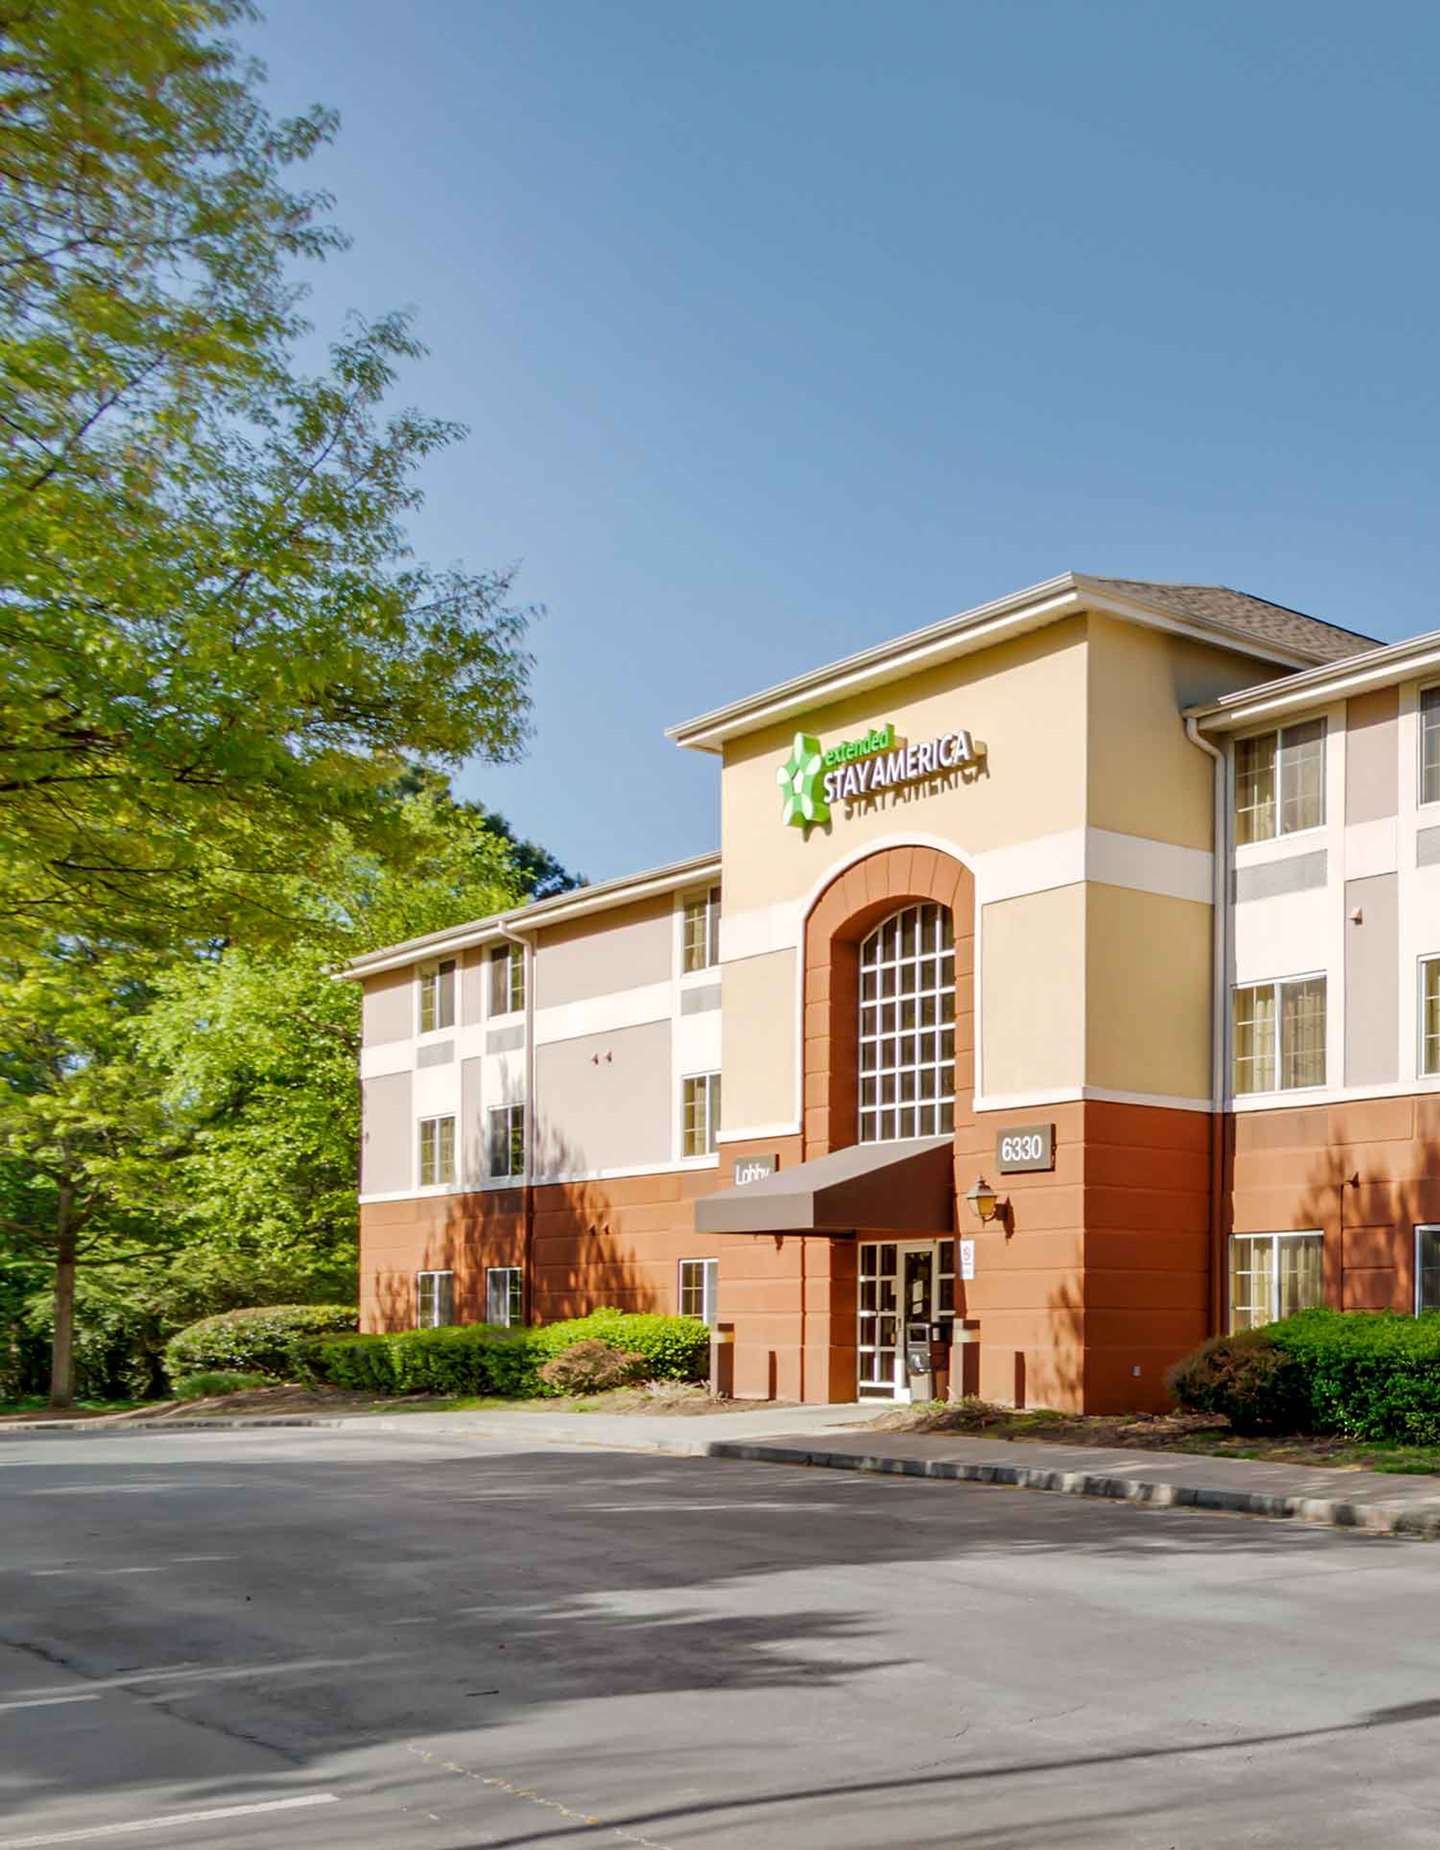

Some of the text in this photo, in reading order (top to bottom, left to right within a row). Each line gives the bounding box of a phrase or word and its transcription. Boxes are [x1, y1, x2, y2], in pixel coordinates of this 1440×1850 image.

[823, 725, 891, 767] extended
[823, 729, 972, 804] STAY AMERICA
[1001, 1134, 1042, 1162] 6330
